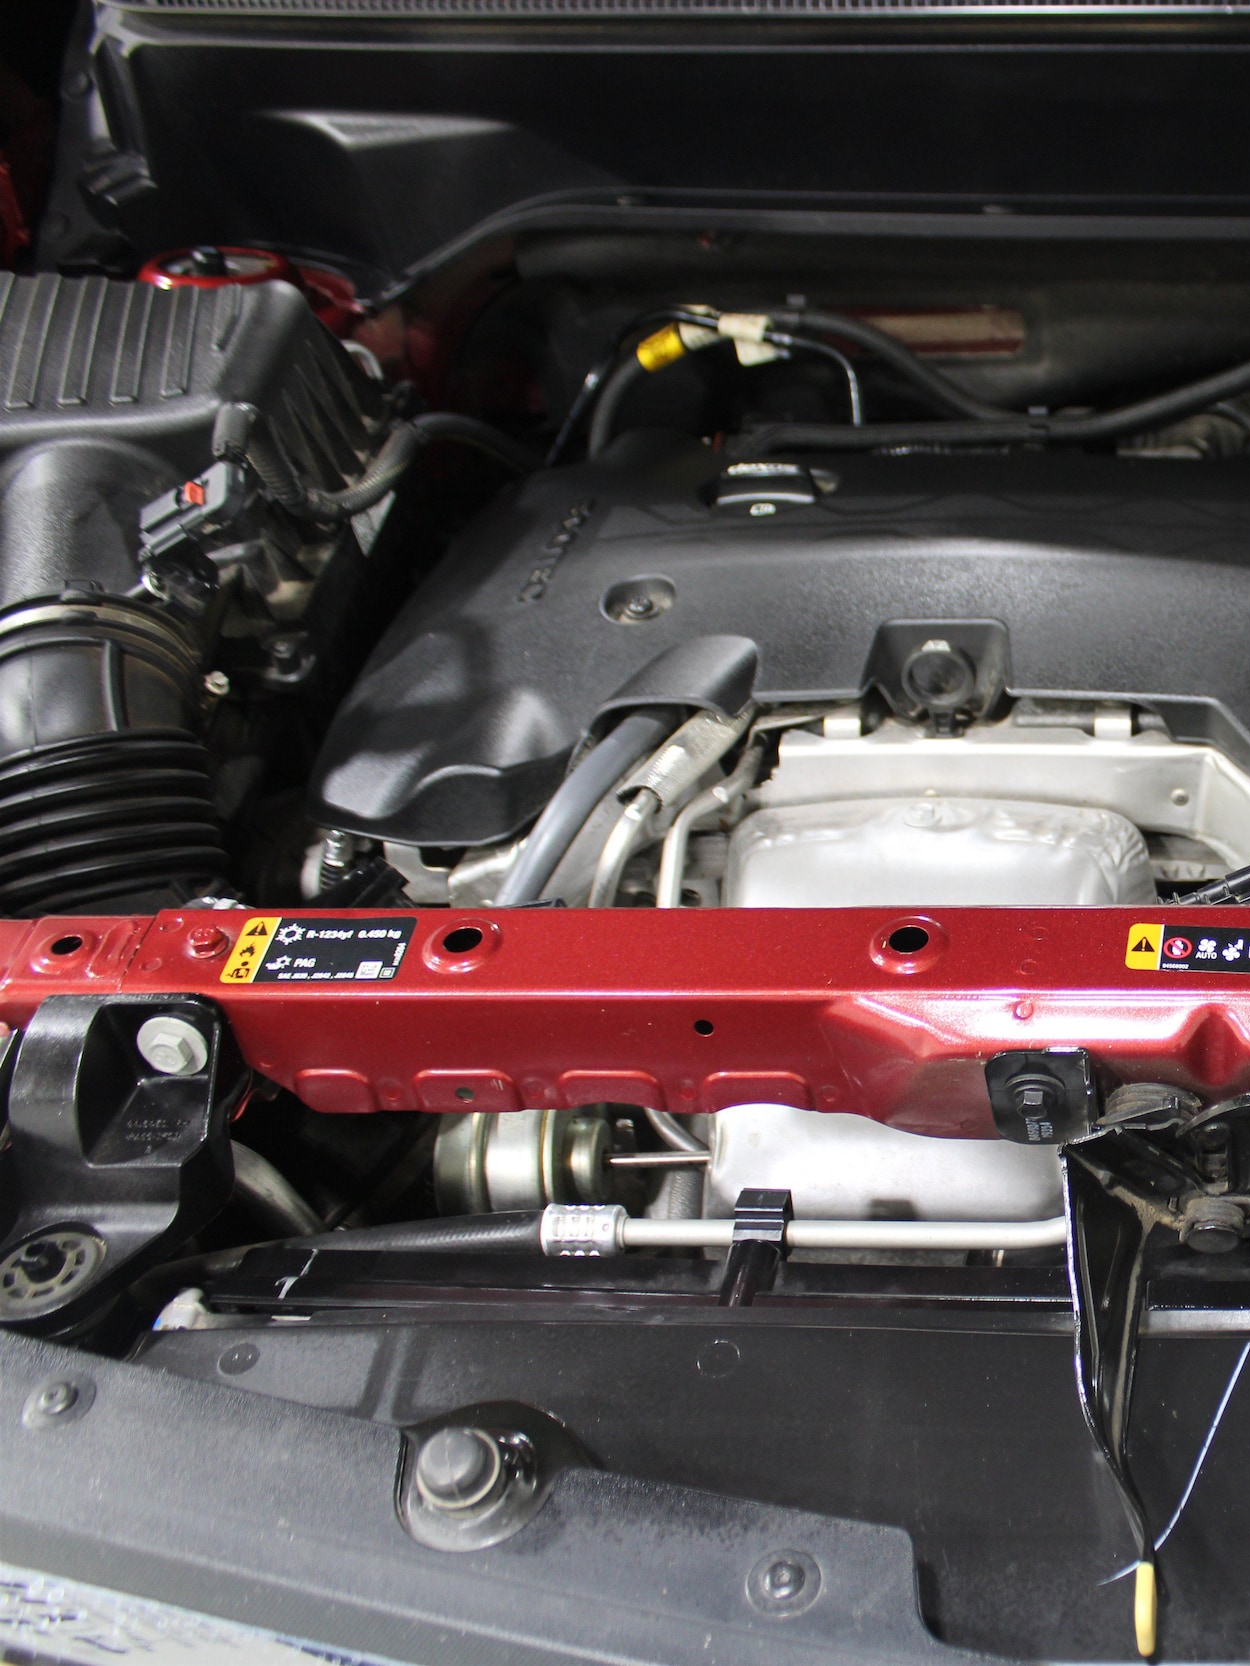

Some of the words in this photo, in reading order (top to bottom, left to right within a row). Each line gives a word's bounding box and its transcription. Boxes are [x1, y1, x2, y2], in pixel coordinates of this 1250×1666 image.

[357, 929, 388, 939] 0.450
[387, 929, 402, 940] kg
[1195, 952, 1217, 960] AUTO
[293, 957, 317, 968] PAG
